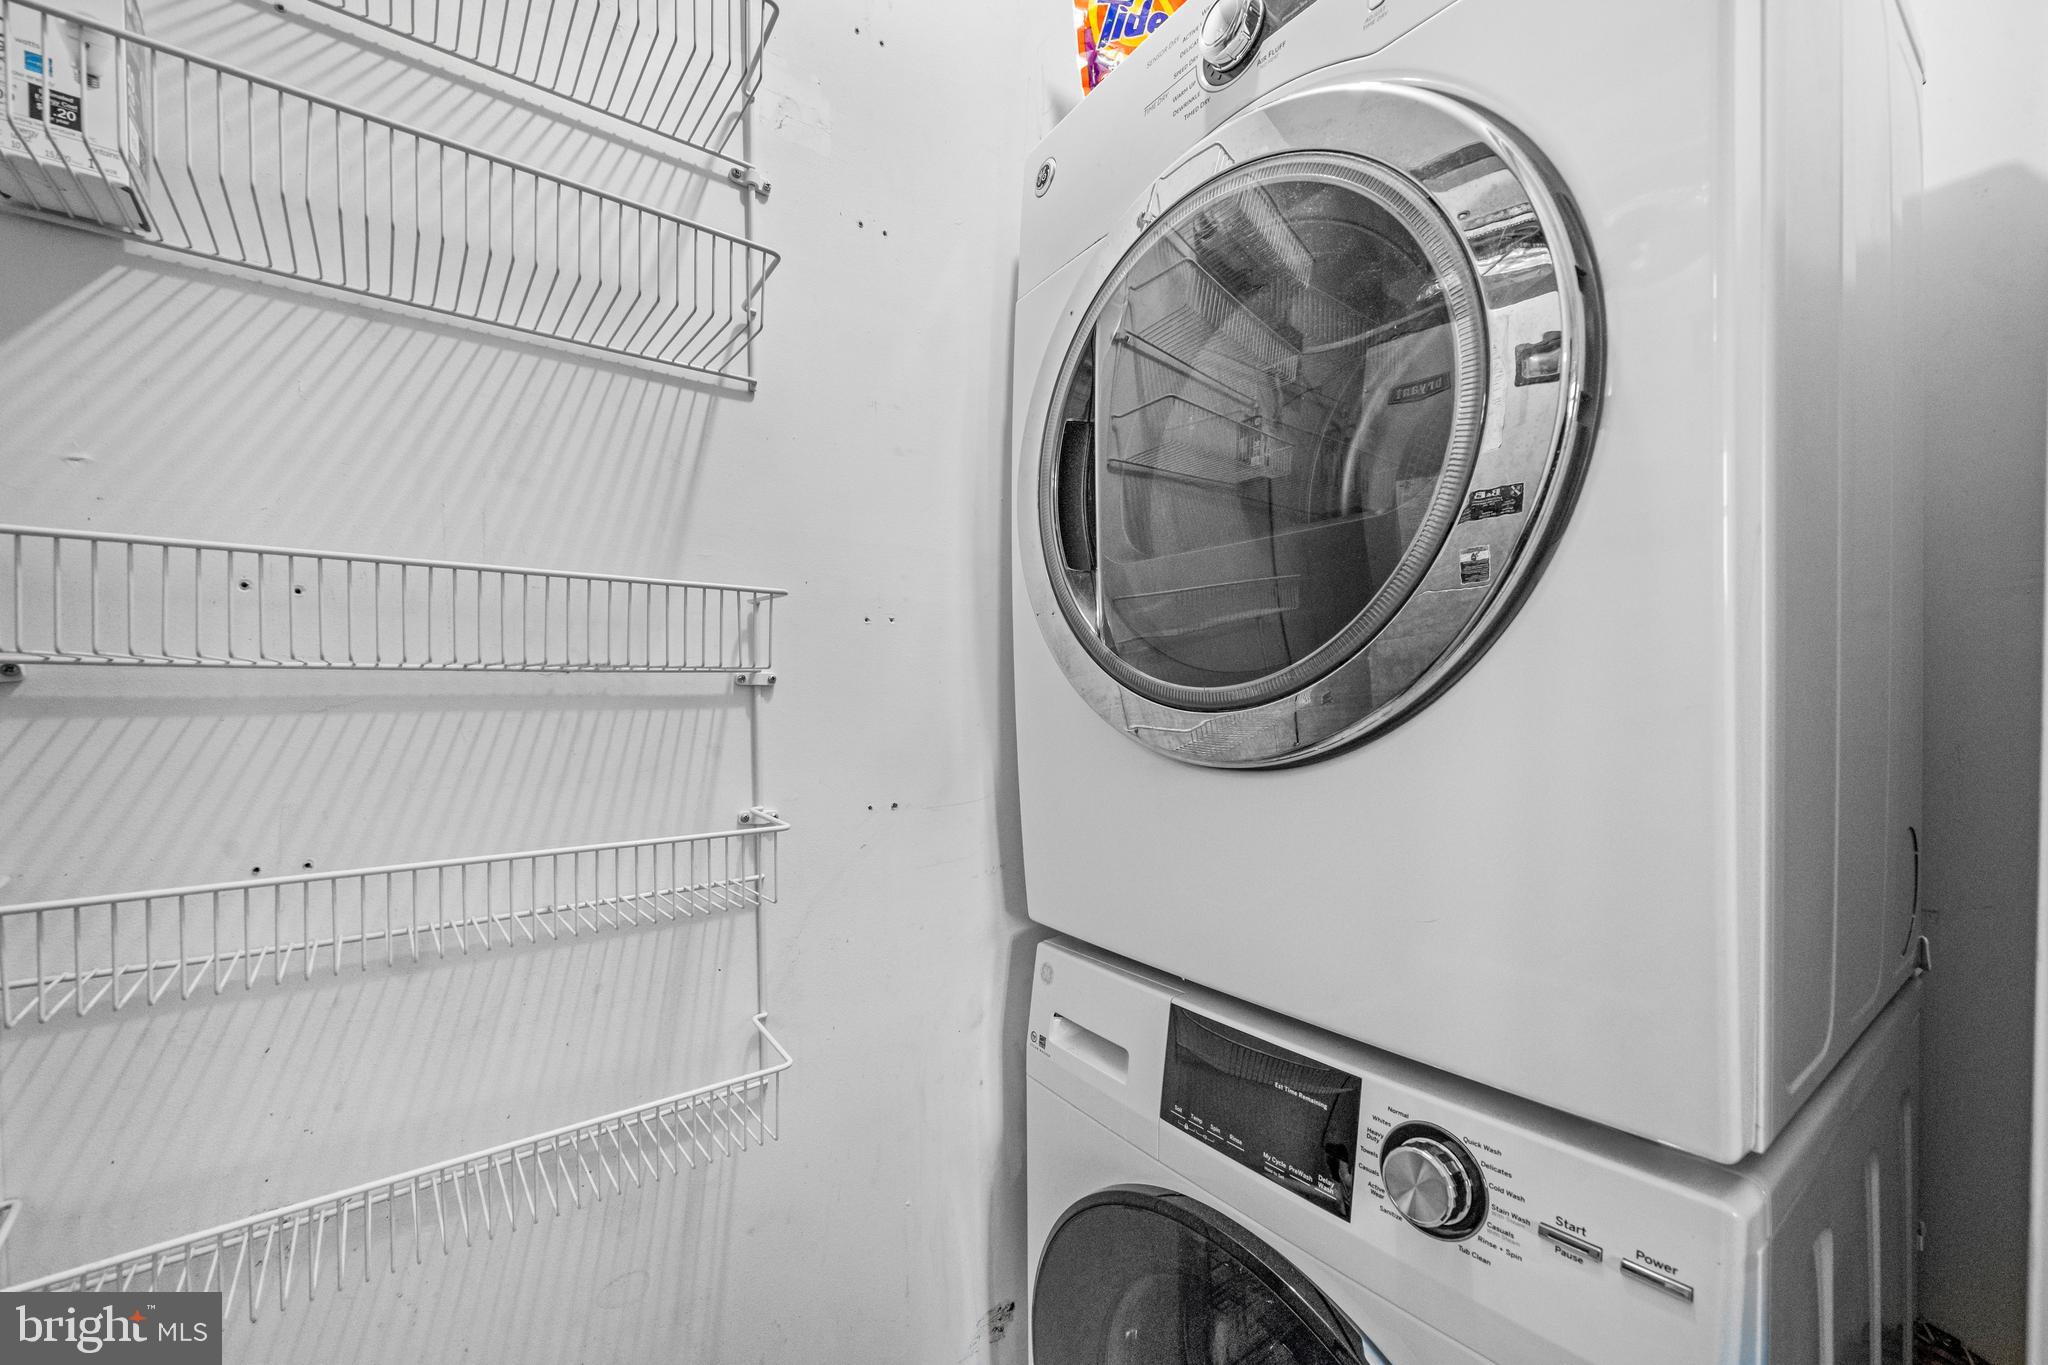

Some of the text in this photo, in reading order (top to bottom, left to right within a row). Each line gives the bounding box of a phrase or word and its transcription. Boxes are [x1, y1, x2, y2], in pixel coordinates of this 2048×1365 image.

[1097, 0, 1169, 49] Tide
[1274, 1081, 1327, 1111] Est Time Remaining
[1372, 1115, 1392, 1127] Whites
[1387, 1106, 1410, 1119] Normal
[1366, 1127, 1384, 1139] Heavy
[1366, 1133, 1380, 1144] Duty
[1360, 1145, 1378, 1158] Towels
[1463, 1136, 1502, 1156] Quick Wash
[1262, 1151, 1272, 1162] My
[1271, 1156, 1287, 1169] Cycle
[1358, 1162, 1380, 1177] Casuals
[1480, 1160, 1512, 1179] Delicates
[1317, 1174, 1335, 1188] Delay
[1317, 1182, 1335, 1195] Wash
[1367, 1181, 1386, 1193] Active
[1370, 1189, 1385, 1199] Wear
[1488, 1182, 1526, 1203] Cold Wash
[1379, 1205, 1403, 1222] Sanitize
[1491, 1203, 1531, 1226] Stain Wash
[1486, 1221, 1515, 1239] Casuals
[1555, 1215, 1587, 1237] Start
[1457, 1244, 1491, 1266] Tub Clean
[1477, 1235, 1498, 1249] Rinse
[1505, 1248, 1523, 1262] Spin
[1554, 1245, 1584, 1264] Pause
[1635, 1249, 1679, 1275] Power
